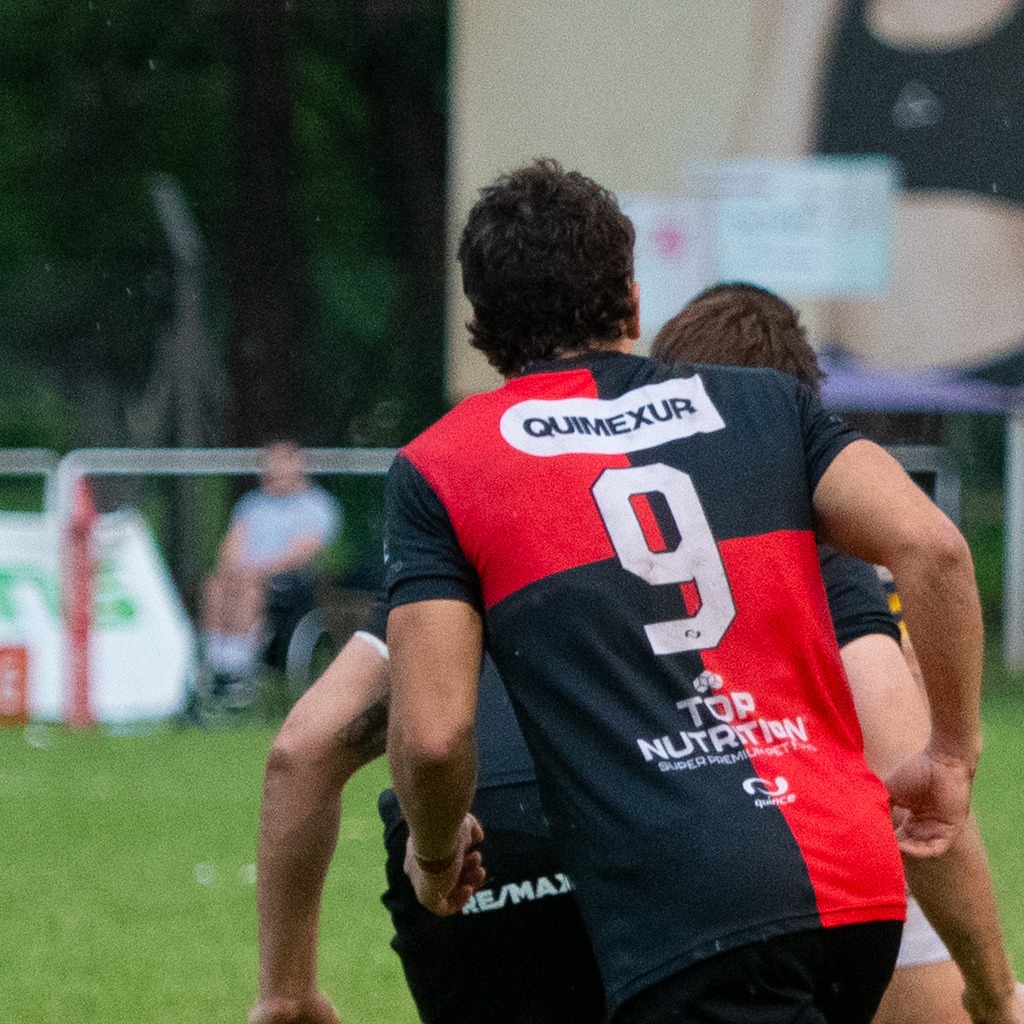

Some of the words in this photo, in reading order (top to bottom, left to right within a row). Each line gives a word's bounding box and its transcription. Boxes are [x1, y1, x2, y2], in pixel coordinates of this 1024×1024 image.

[523, 397, 696, 437] QUIMEXUR
[591, 462, 737, 655] 9
[676, 691, 756, 727] TOP
[636, 716, 809, 762] NUTRITION
[658, 756, 707, 773] SUPER
